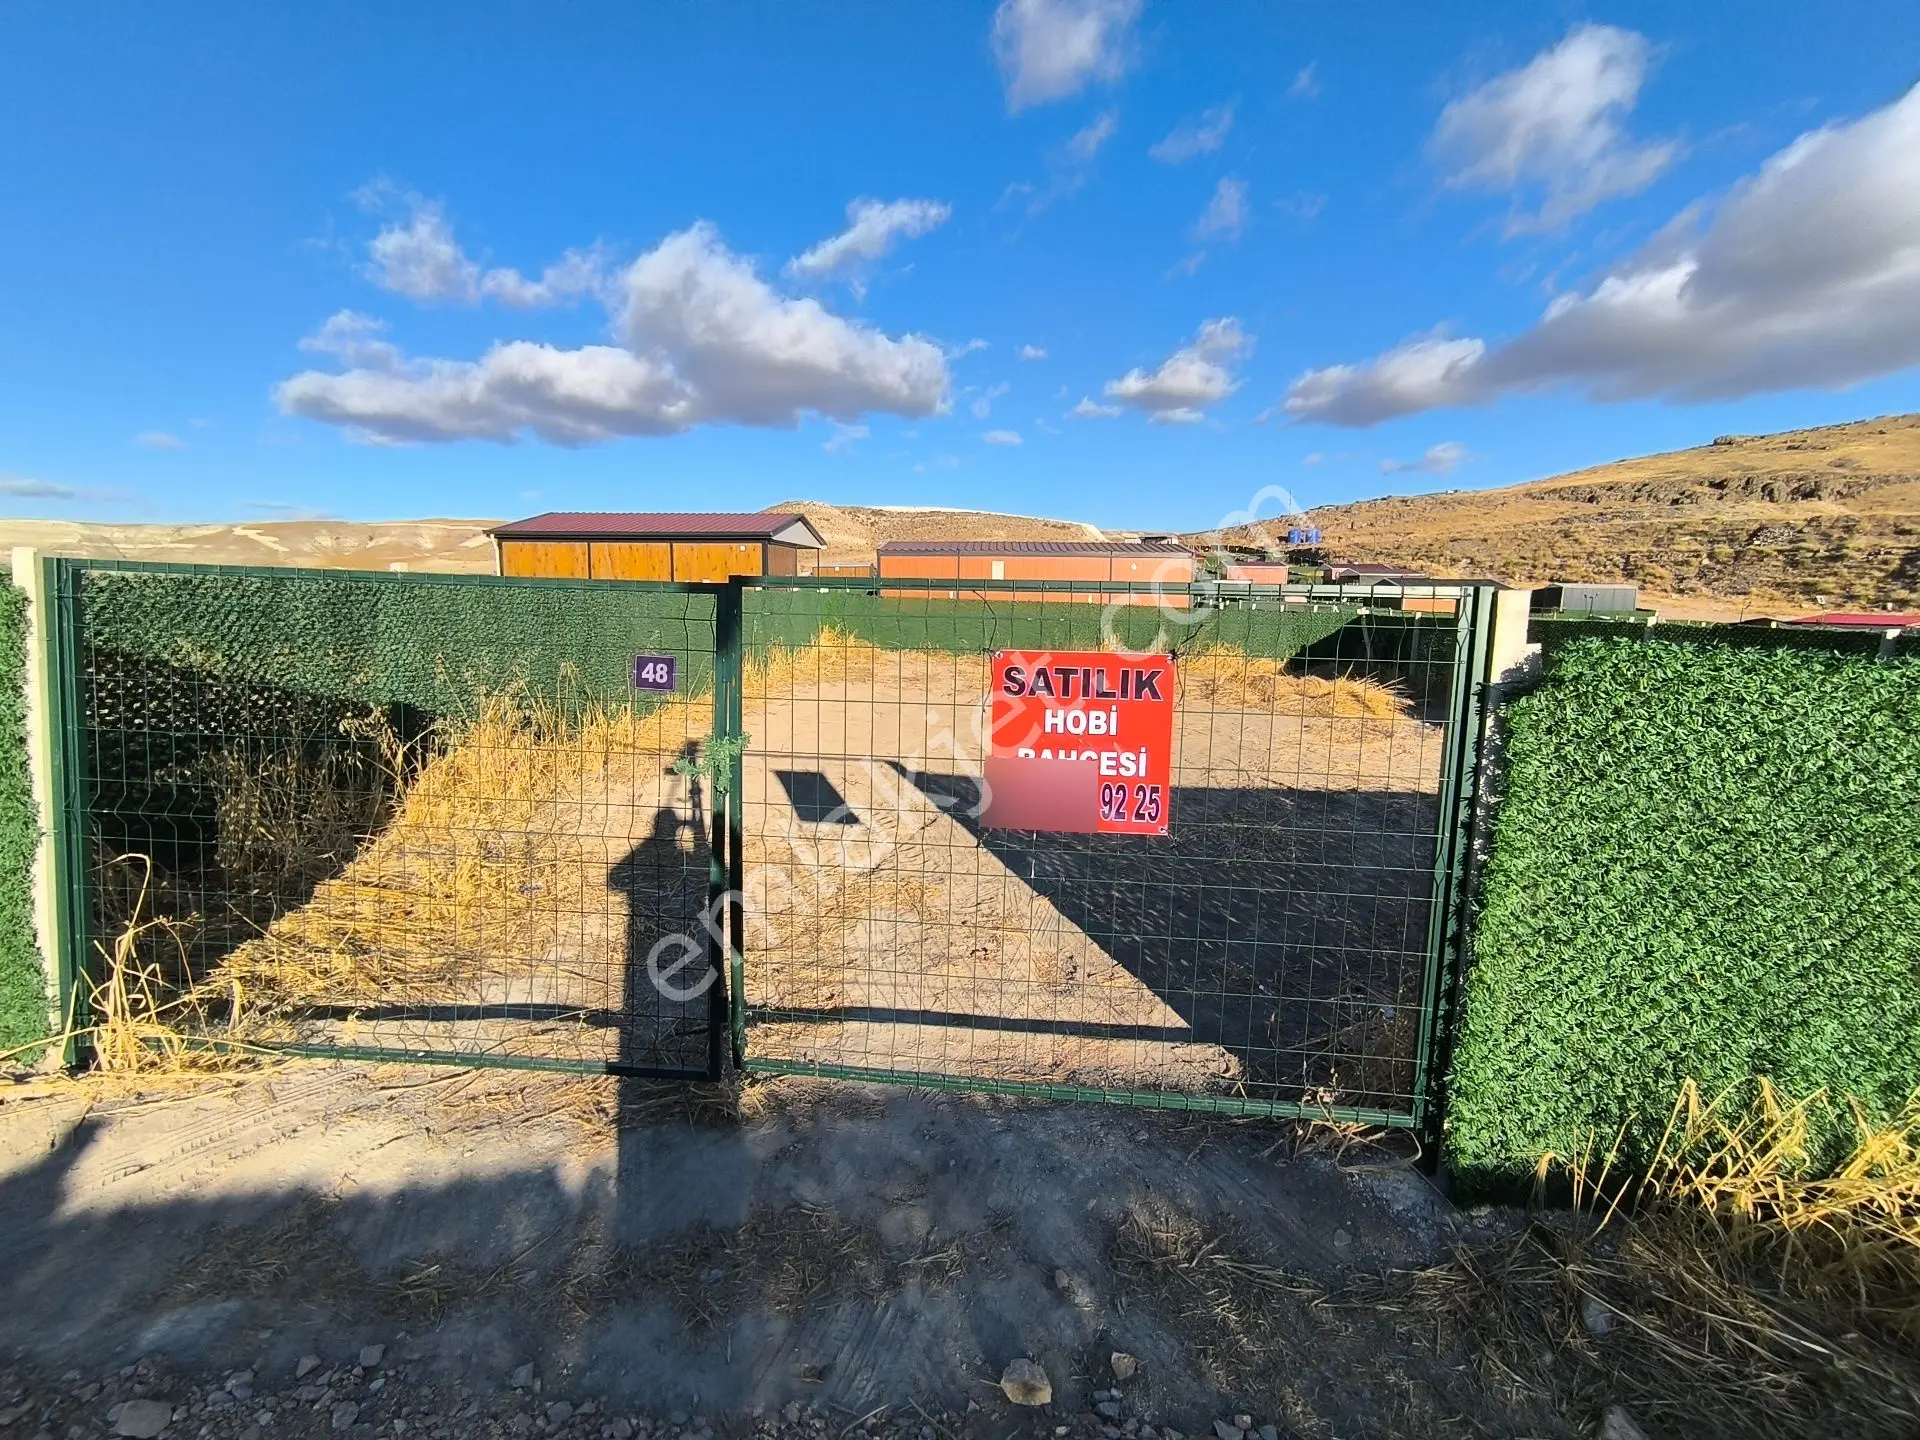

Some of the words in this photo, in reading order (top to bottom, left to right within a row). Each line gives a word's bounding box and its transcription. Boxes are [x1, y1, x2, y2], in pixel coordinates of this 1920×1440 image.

[641, 662, 668, 684] 48
[1002, 666, 1163, 702] SATILIK
[1044, 705, 1117, 736] HOBİ
[1100, 782, 1127, 822] 92
[1132, 783, 1161, 823] 25
